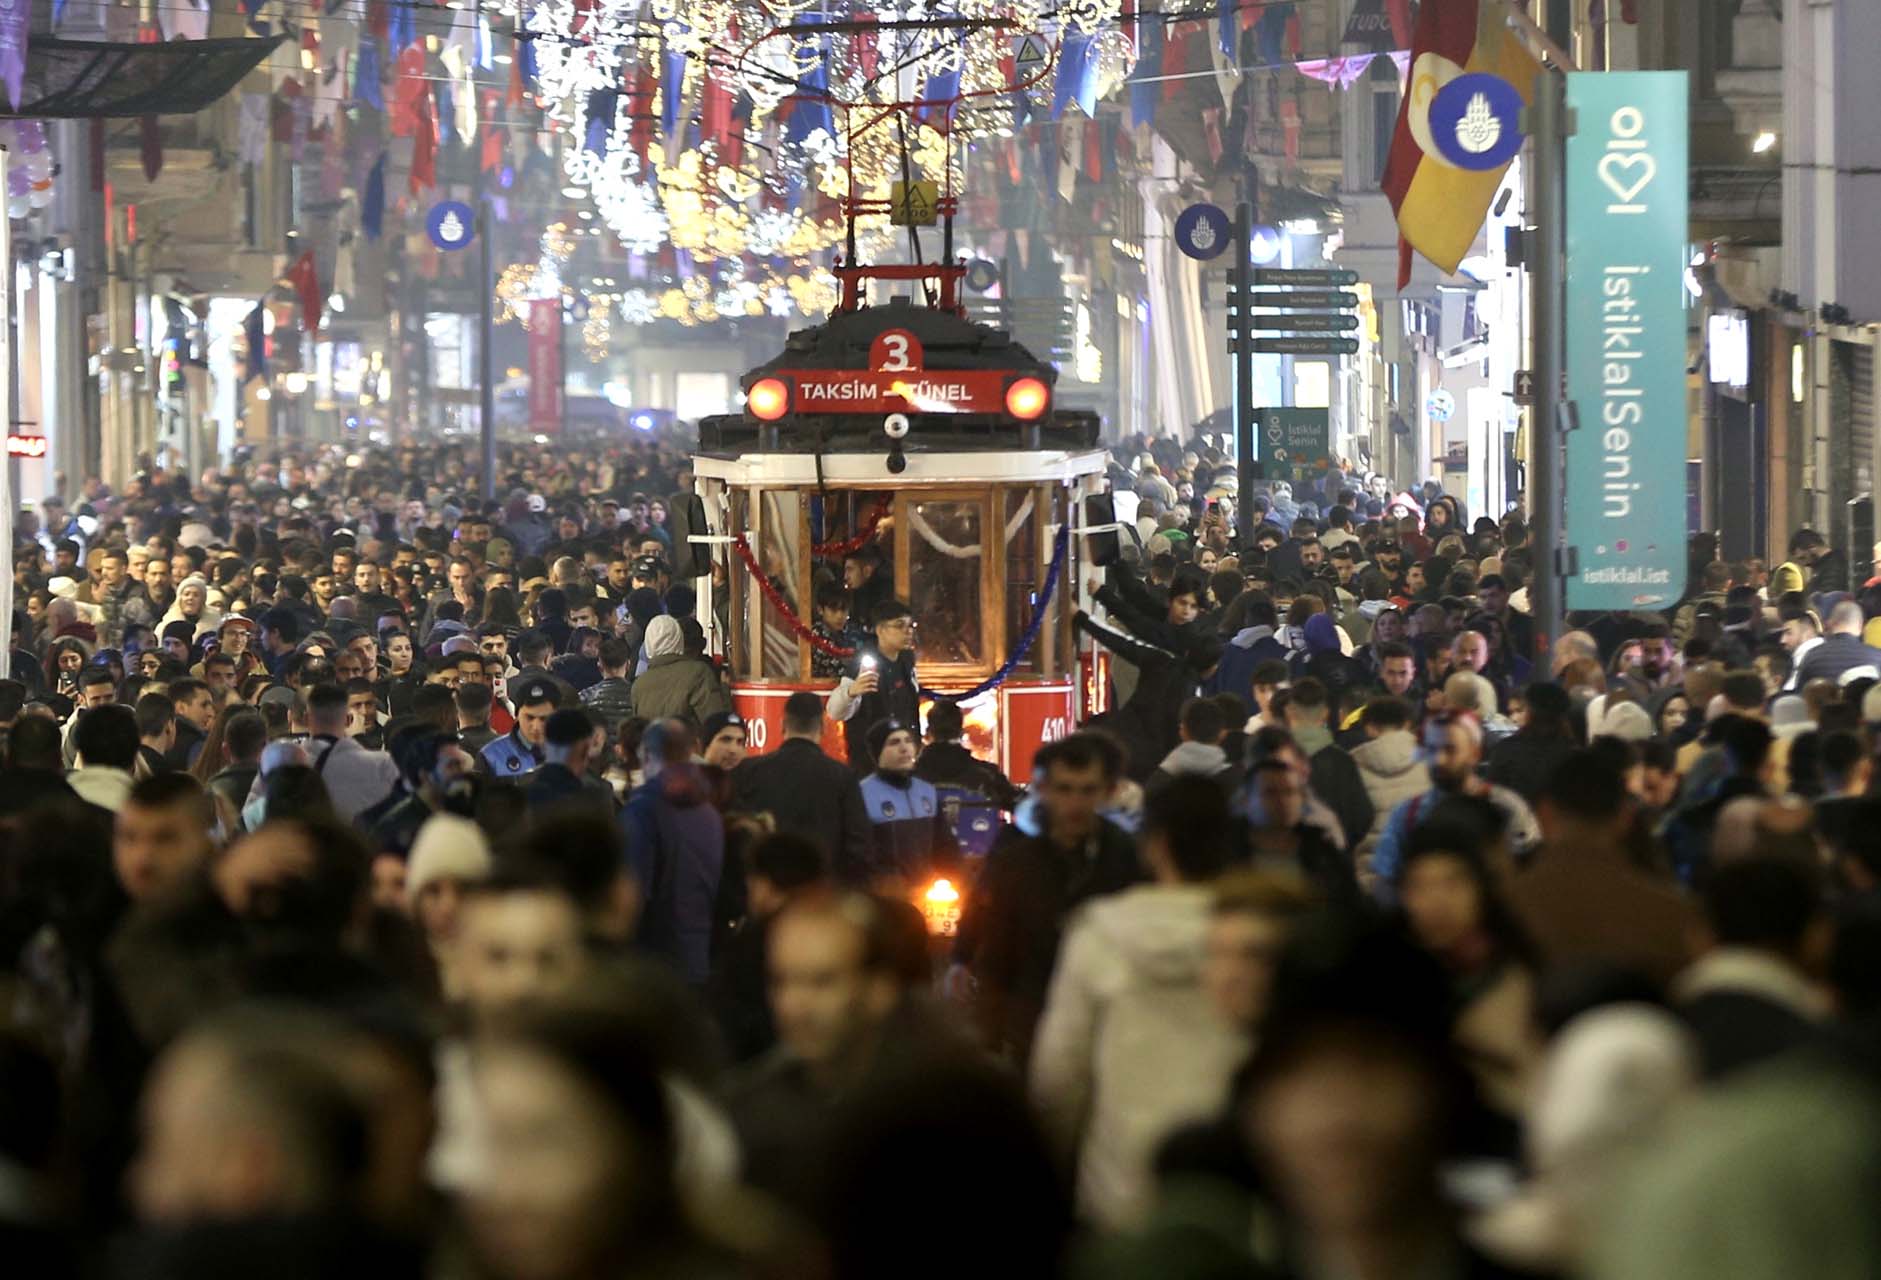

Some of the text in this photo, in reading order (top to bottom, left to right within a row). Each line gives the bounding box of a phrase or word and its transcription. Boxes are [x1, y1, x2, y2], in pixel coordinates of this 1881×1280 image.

[883, 334, 909, 372] 3
[801, 379, 877, 400] TAKSİM
[909, 380, 972, 400] TÜNEL
[1584, 567, 1671, 585] istiklal.ist
[743, 717, 767, 748] 10
